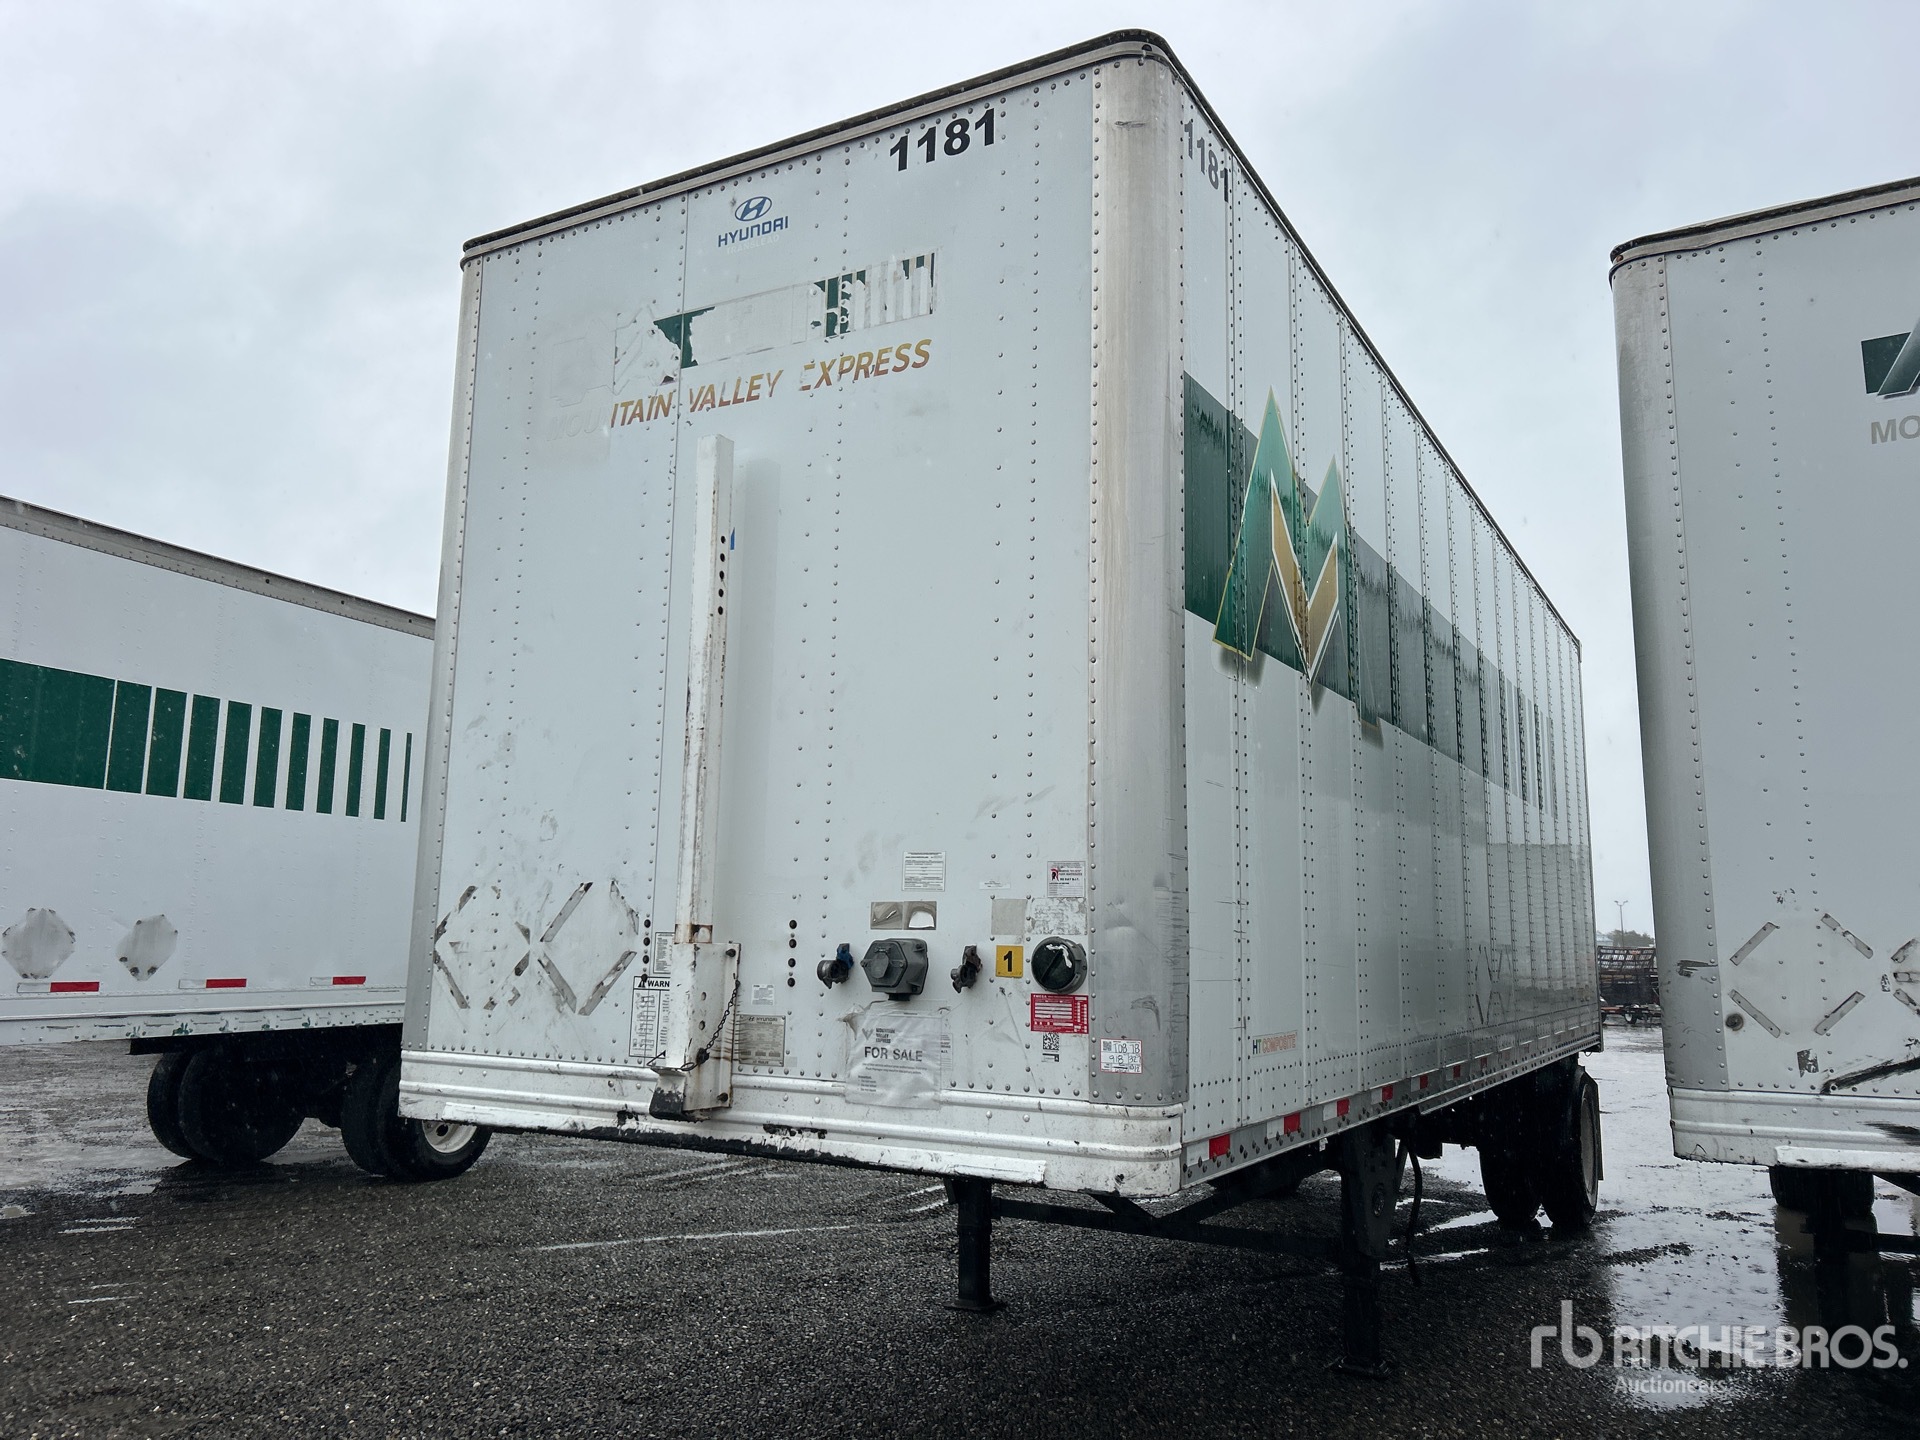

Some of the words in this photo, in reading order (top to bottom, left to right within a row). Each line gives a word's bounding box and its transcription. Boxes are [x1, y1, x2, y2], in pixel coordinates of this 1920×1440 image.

[889, 107, 995, 172] 1181
[1184, 120, 1229, 204] 1181
[718, 215, 789, 248] HYUNDAI
[689, 369, 784, 413] VALLEY
[799, 338, 933, 392] EXPRESS
[1871, 415, 1920, 445] MO
[1003, 950, 1013, 973] 1
[864, 1046, 889, 1060] FOR
[892, 1048, 923, 1062] SALE
[1252, 1039, 1261, 1055] HT
[1262, 1033, 1297, 1054] COMPOSITE
